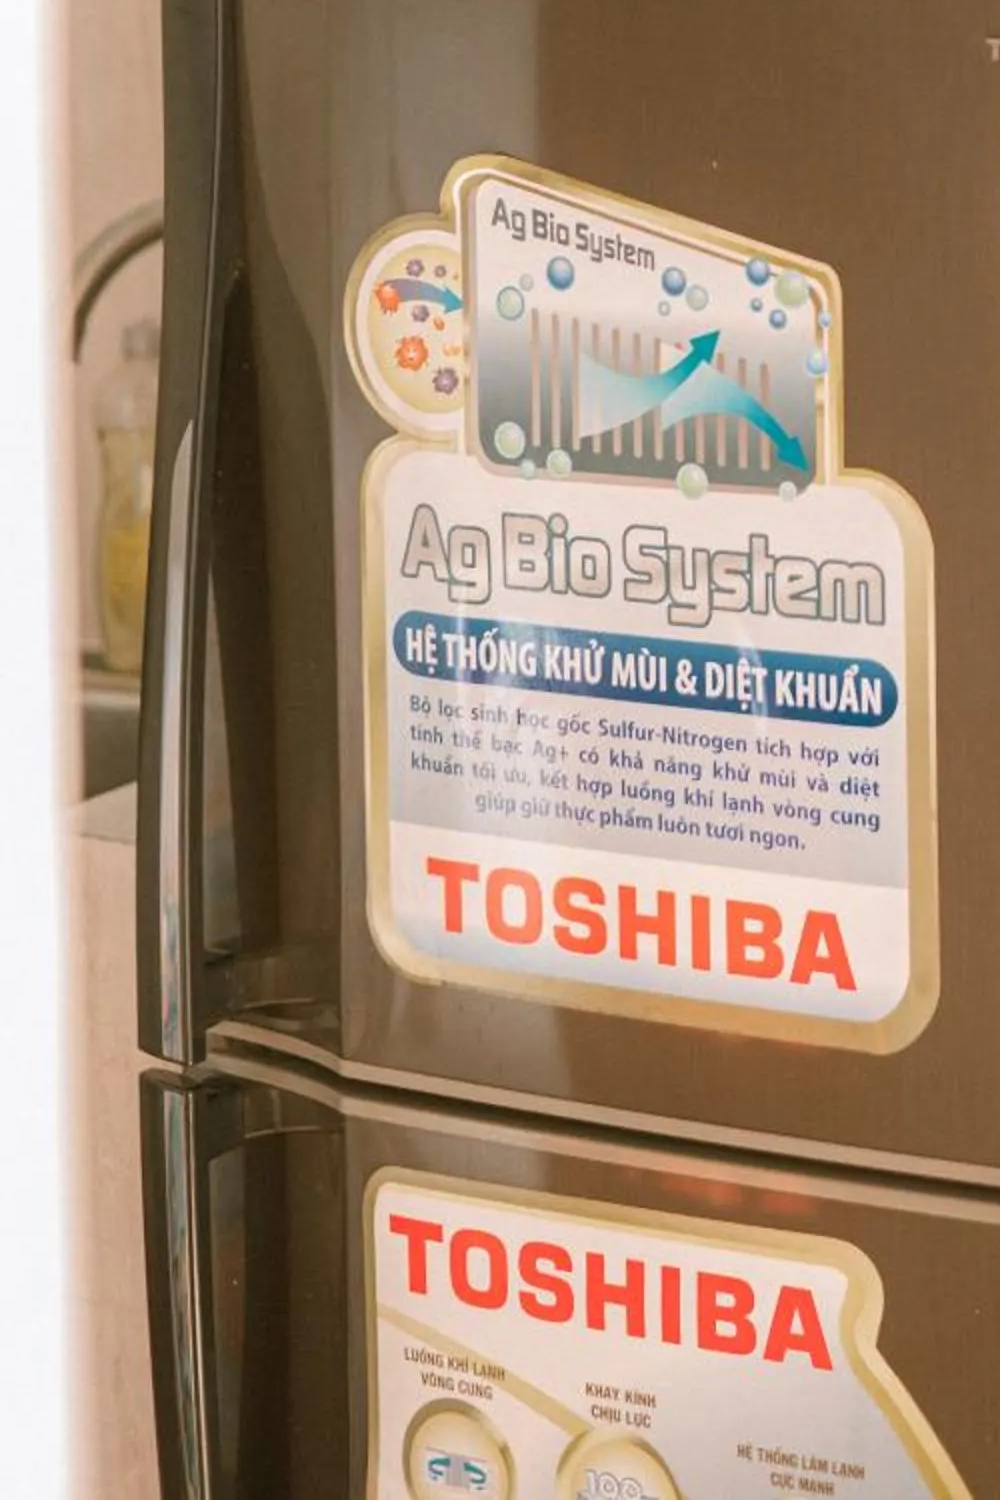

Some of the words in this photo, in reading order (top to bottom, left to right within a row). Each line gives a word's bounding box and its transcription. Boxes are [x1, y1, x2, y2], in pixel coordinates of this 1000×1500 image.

[491, 197, 526, 242] Ag
[532, 208, 570, 246] Bio
[575, 222, 655, 271] System
[401, 502, 492, 604] Ag
[501, 511, 612, 599] Bio
[622, 523, 886, 628] System
[405, 623, 438, 674] HỆ
[441, 627, 537, 677] THỐNG
[544, 638, 605, 685] KHỬ
[611, 646, 667, 693] MÙI
[674, 658, 697, 696] &
[704, 656, 768, 711] DIỆT
[774, 663, 883, 716] KHUẨN
[409, 694, 431, 718] Bộ
[438, 699, 462, 723] lọc
[471, 703, 508, 725] sinh
[516, 708, 549, 733] học
[556, 713, 591, 736] gốc
[598, 718, 747, 754] Sulfur-Nitrogen
[801, 741, 839, 767] hợp
[848, 746, 879, 767] với
[533, 740, 569, 764] Ag+
[579, 746, 599, 765] có
[609, 749, 644, 770] khả
[760, 768, 796, 789] mùi
[806, 773, 829, 793] và
[839, 775, 880, 802] diệt
[577, 773, 613, 799] hợp
[722, 791, 764, 816] lạnh
[773, 799, 822, 827] vòng
[830, 808, 881, 833] cung
[555, 800, 596, 827] thực
[705, 821, 744, 842] tươi
[750, 828, 806, 851] ngon.
[427, 856, 858, 991] TOSHIBA
[389, 1213, 833, 1371] TOSHIBA
[458, 1380, 493, 1399] CUNG
[585, 1382, 620, 1400] KHAY
